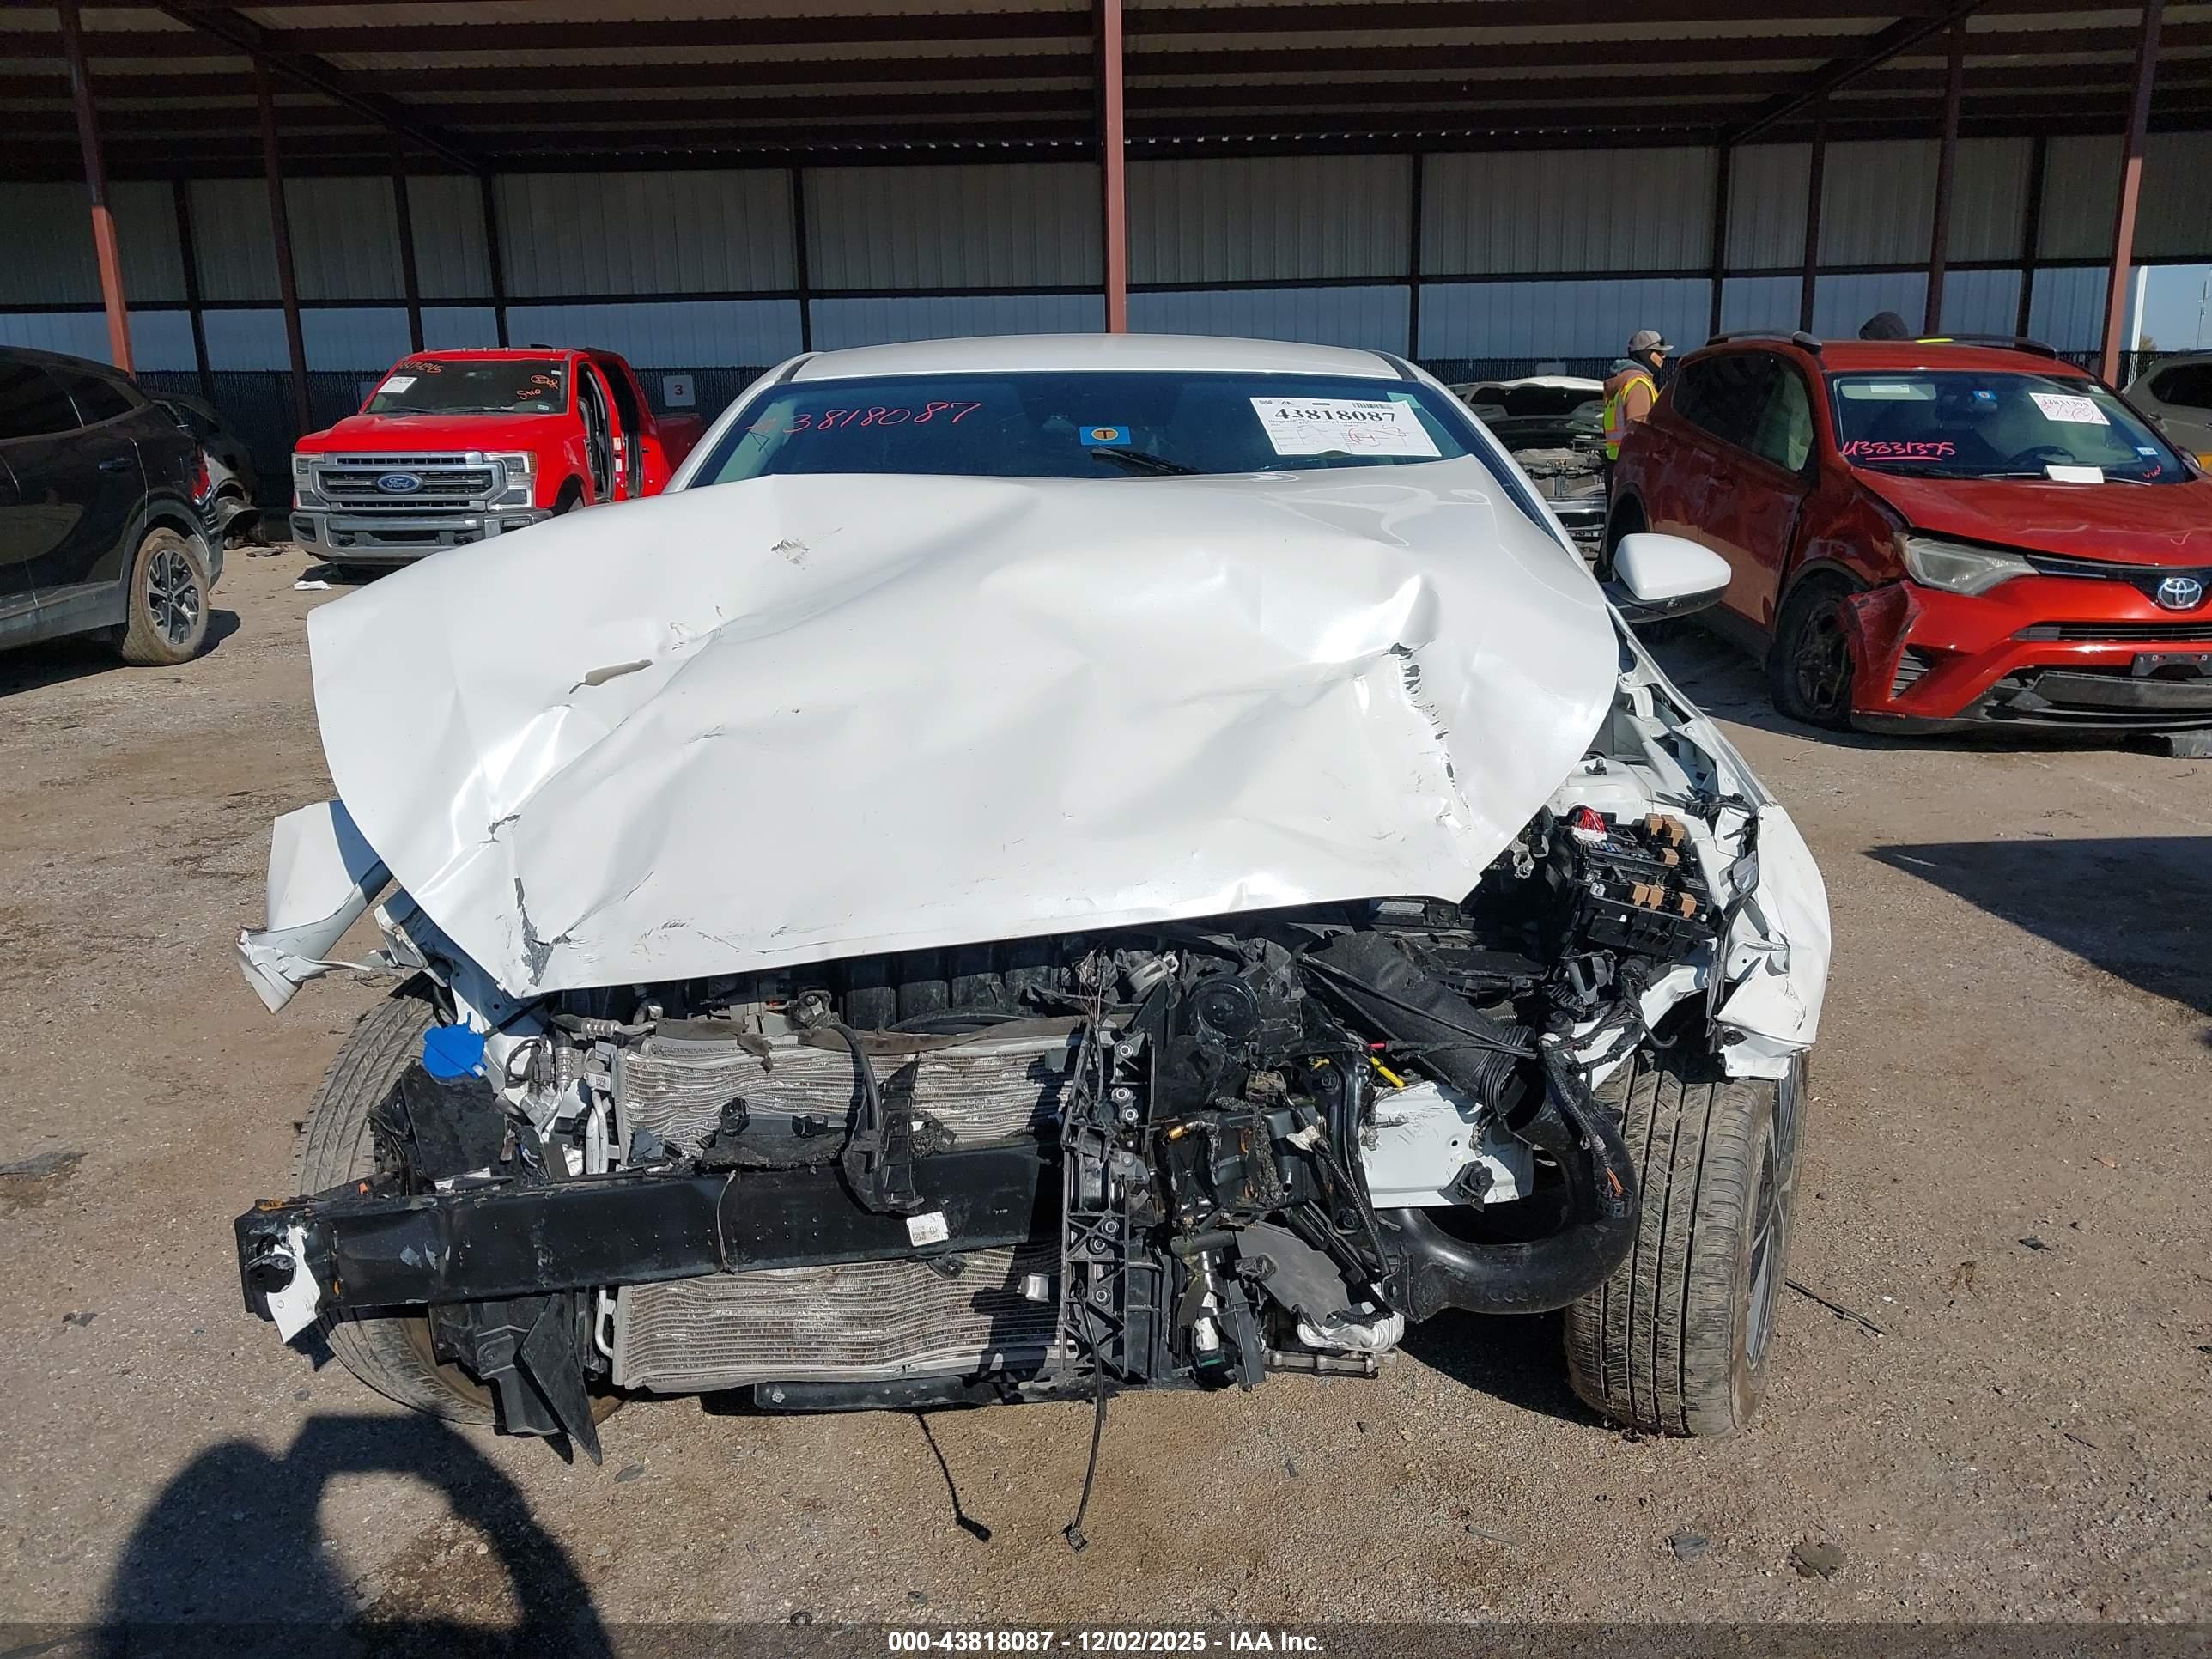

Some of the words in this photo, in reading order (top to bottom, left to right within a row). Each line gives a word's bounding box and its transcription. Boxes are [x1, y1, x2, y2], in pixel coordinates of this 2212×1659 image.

[673, 384, 684, 396] 3
[744, 402, 982, 433] 3818087
[1274, 408, 1395, 422] 43818087
[1096, 429, 1113, 440] T
[386, 477, 410, 489] Ford
